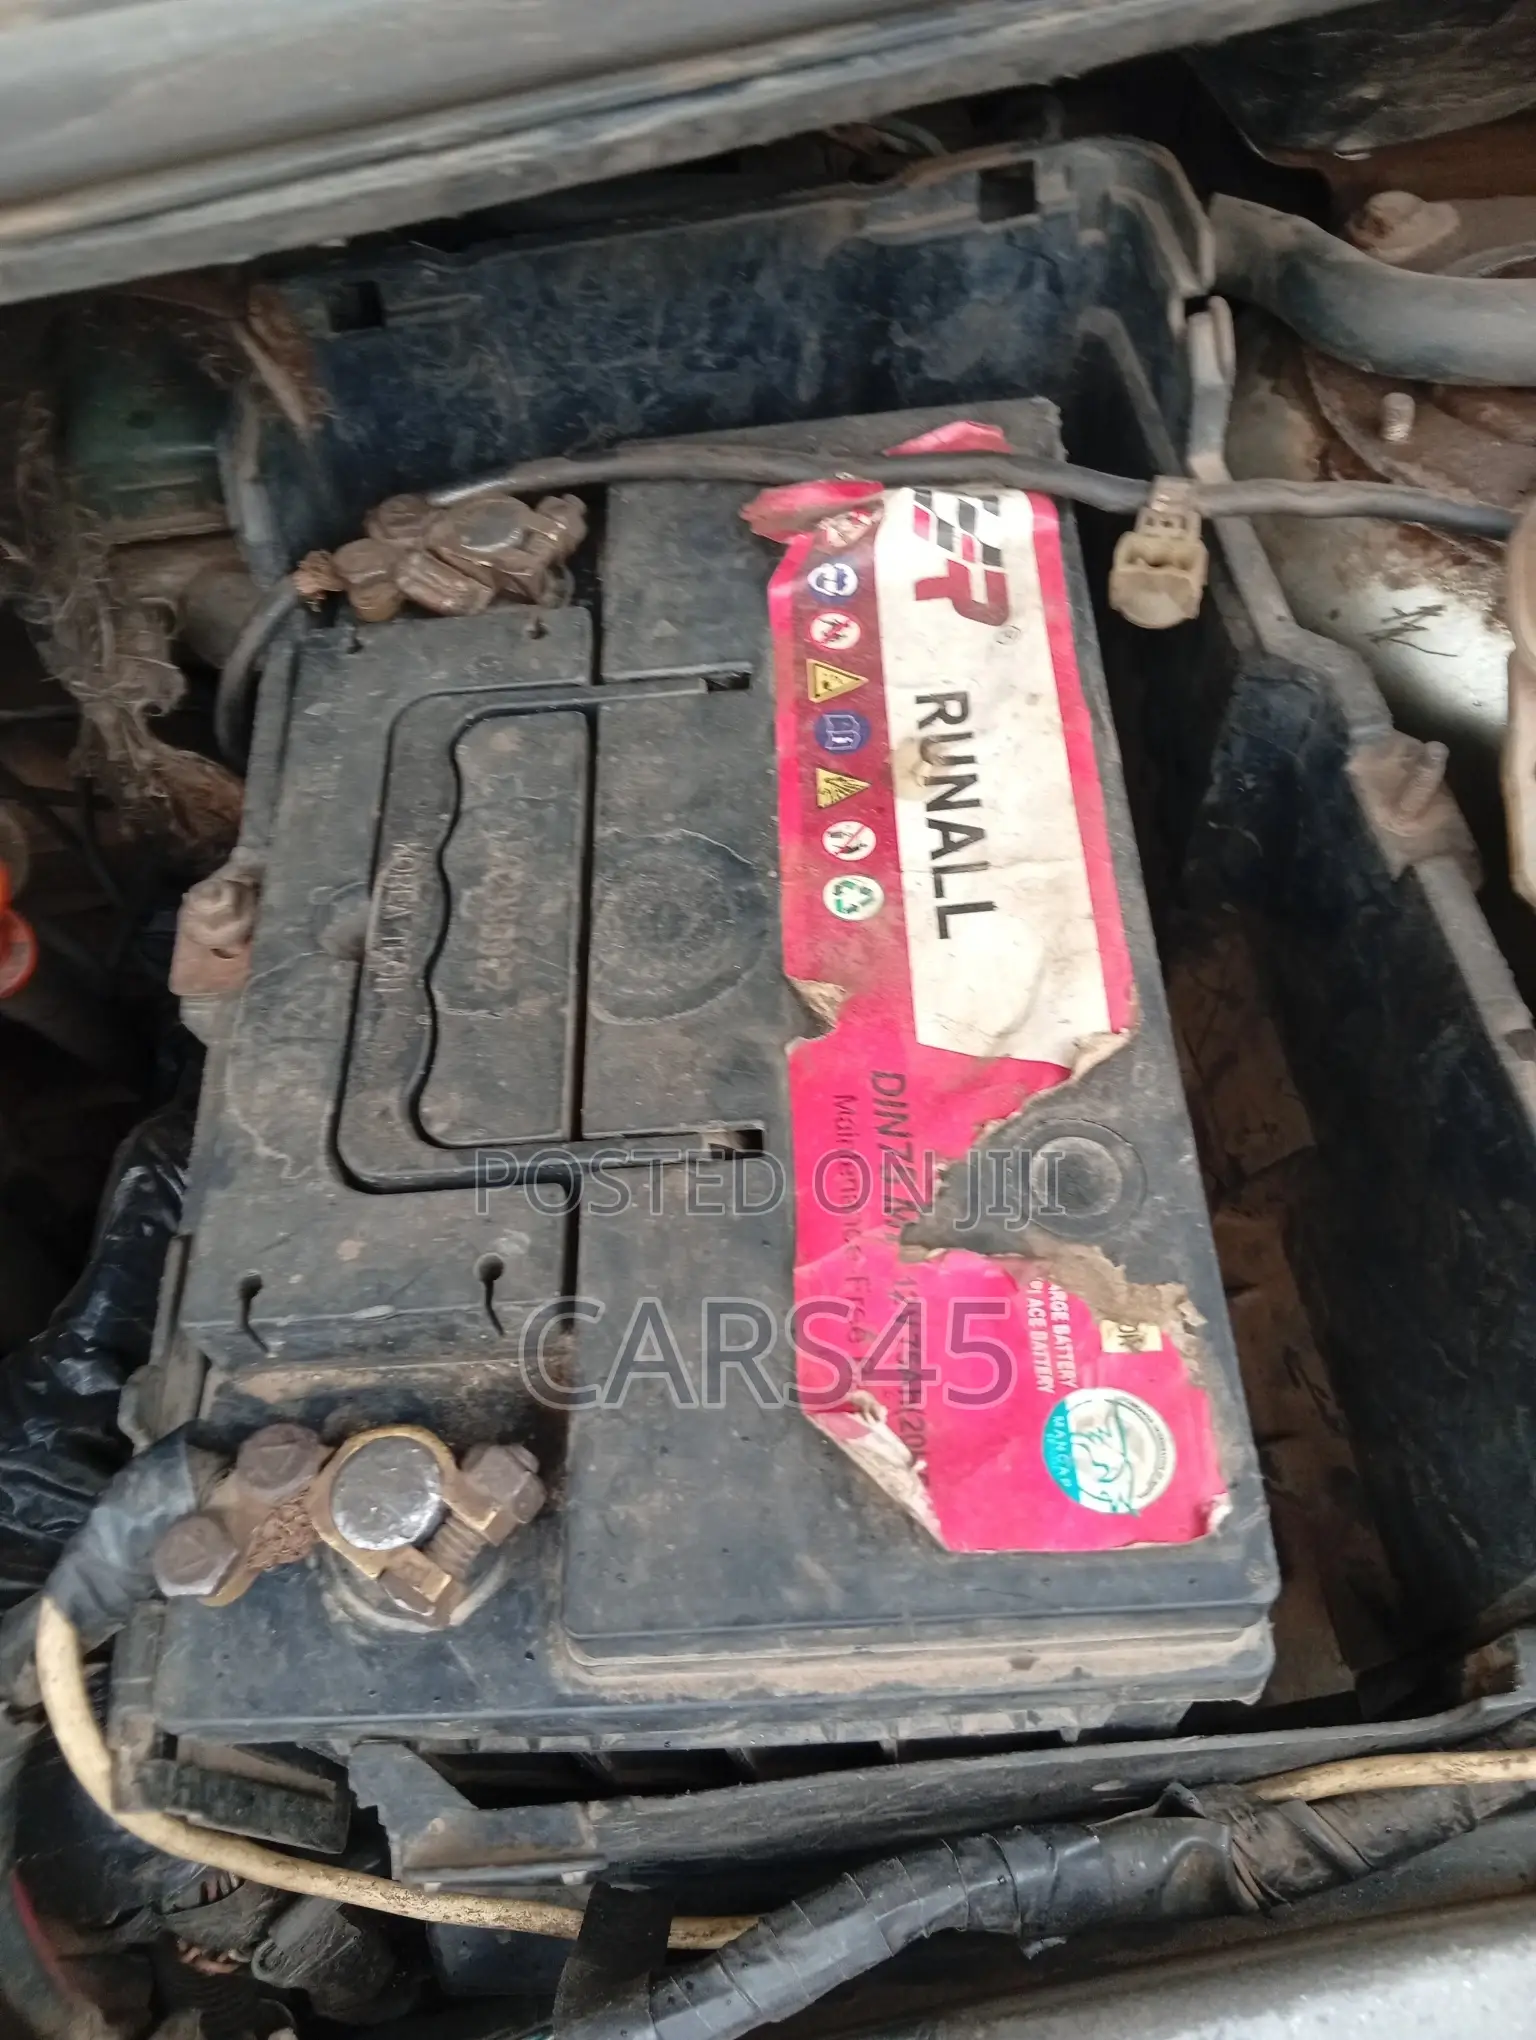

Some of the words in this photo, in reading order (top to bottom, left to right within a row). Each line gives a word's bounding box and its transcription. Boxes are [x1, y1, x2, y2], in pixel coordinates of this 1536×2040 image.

[915, 690, 998, 940] RUNALL
[1029, 1331, 1056, 1395] BATTERY
[1052, 1323, 1079, 1390] BATTERY
[1050, 1414, 1074, 1489] MANCAP
